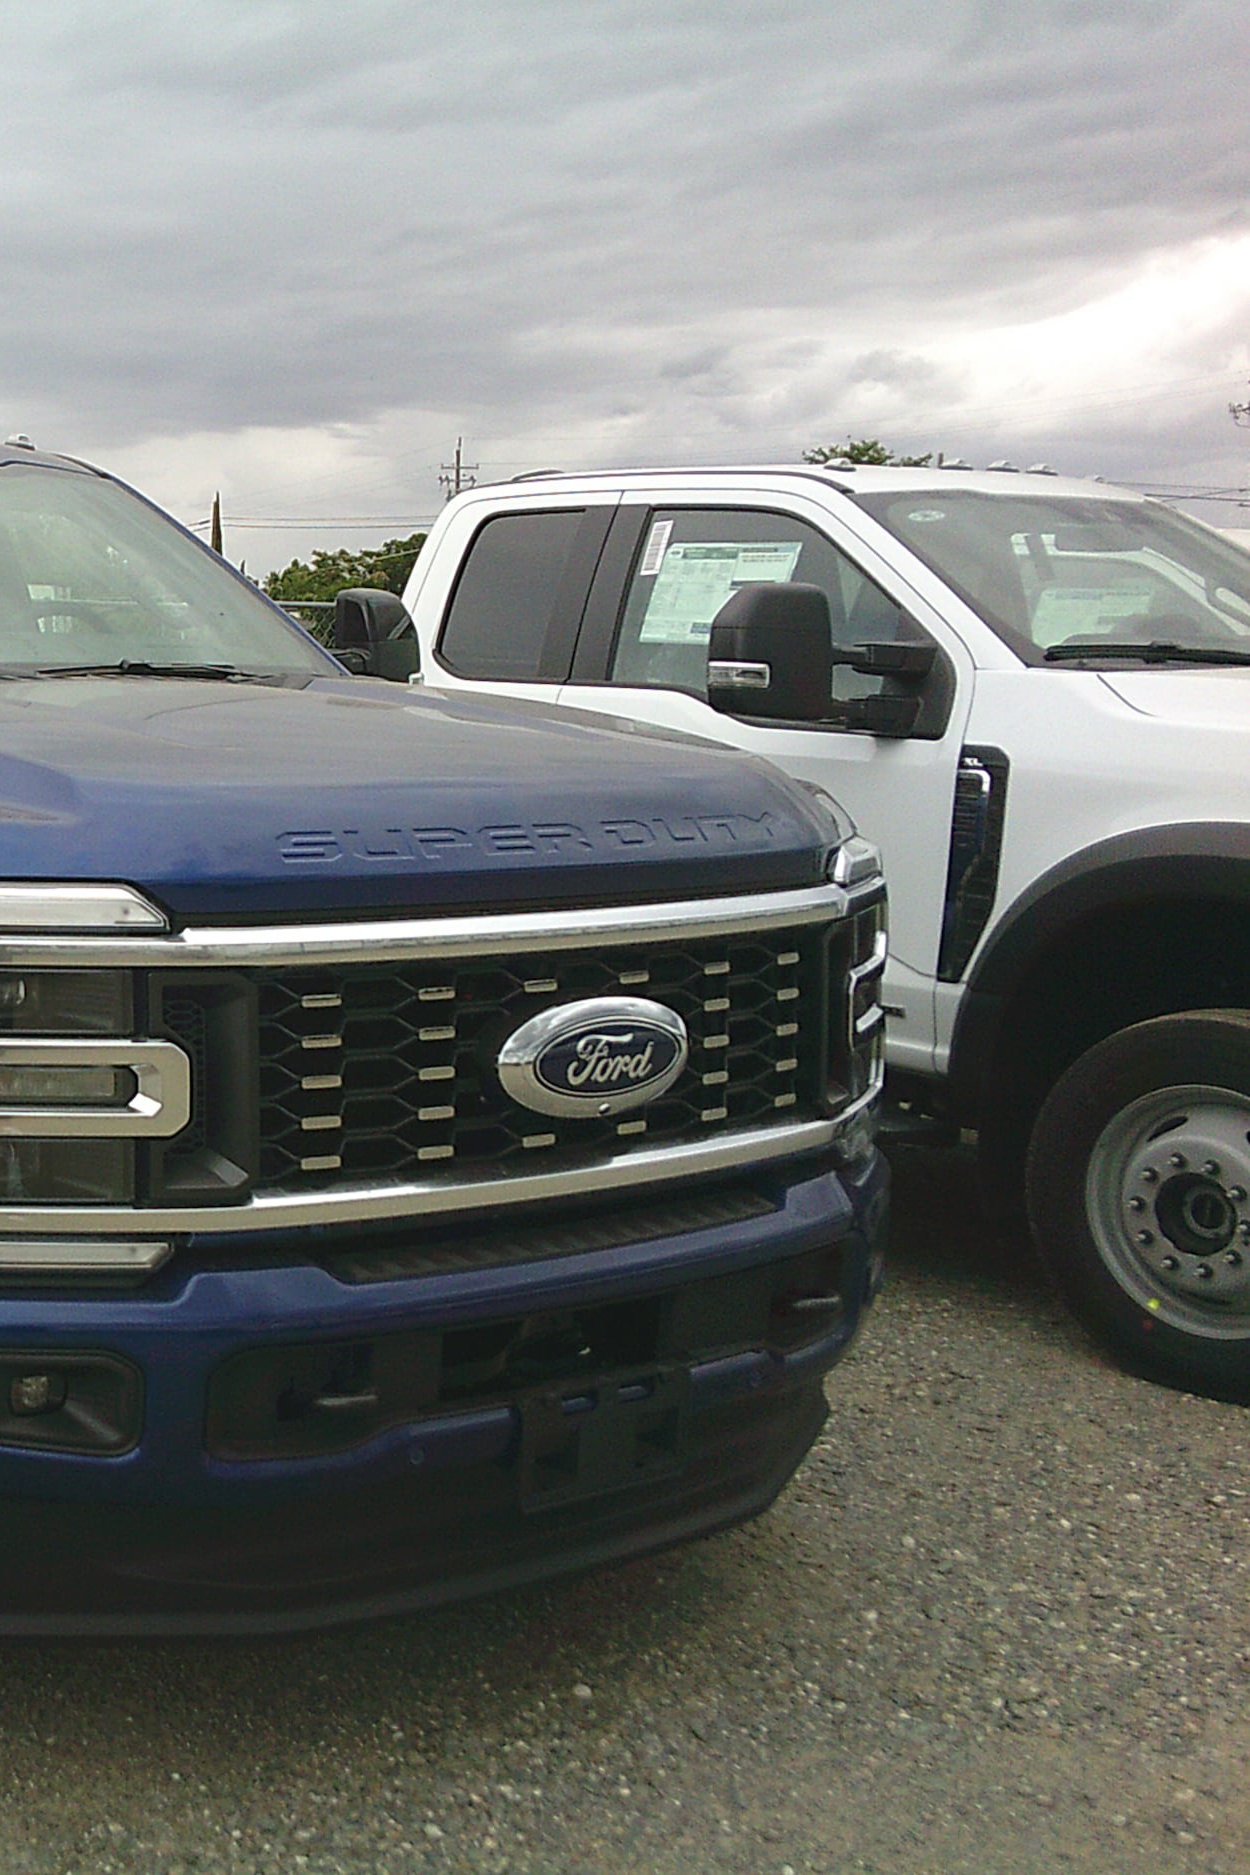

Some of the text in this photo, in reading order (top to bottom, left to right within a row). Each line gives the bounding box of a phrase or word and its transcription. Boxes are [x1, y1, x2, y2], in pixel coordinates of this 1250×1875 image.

[277, 809, 775, 864] SUPER DUTY
[567, 1033, 654, 1086] Ford
